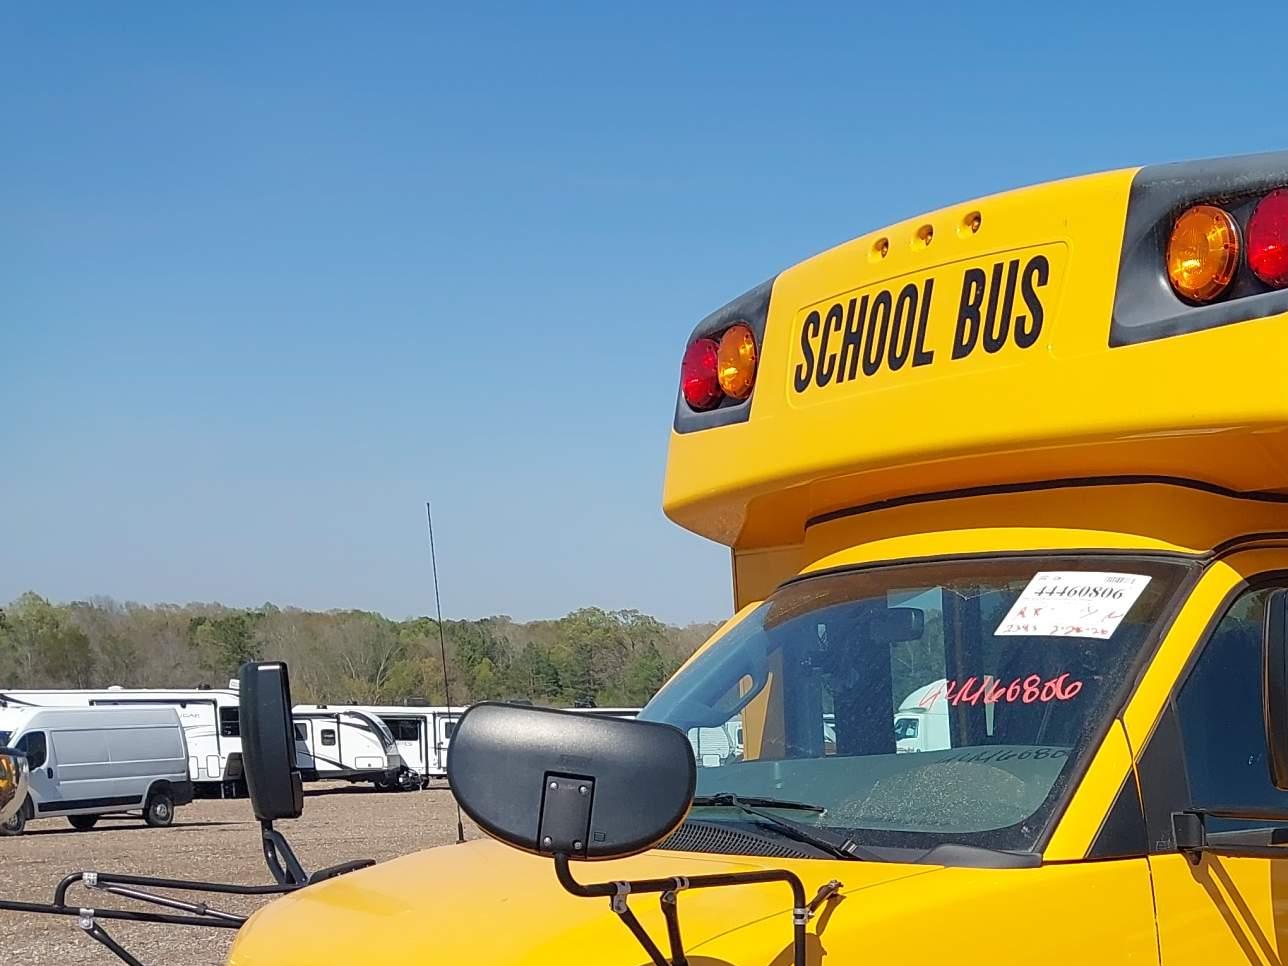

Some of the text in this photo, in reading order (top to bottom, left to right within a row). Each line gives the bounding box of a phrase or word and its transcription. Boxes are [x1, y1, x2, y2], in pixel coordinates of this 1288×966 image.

[793, 254, 1050, 393] SCHOOL BUS
[1034, 584, 1124, 600] 44460806
